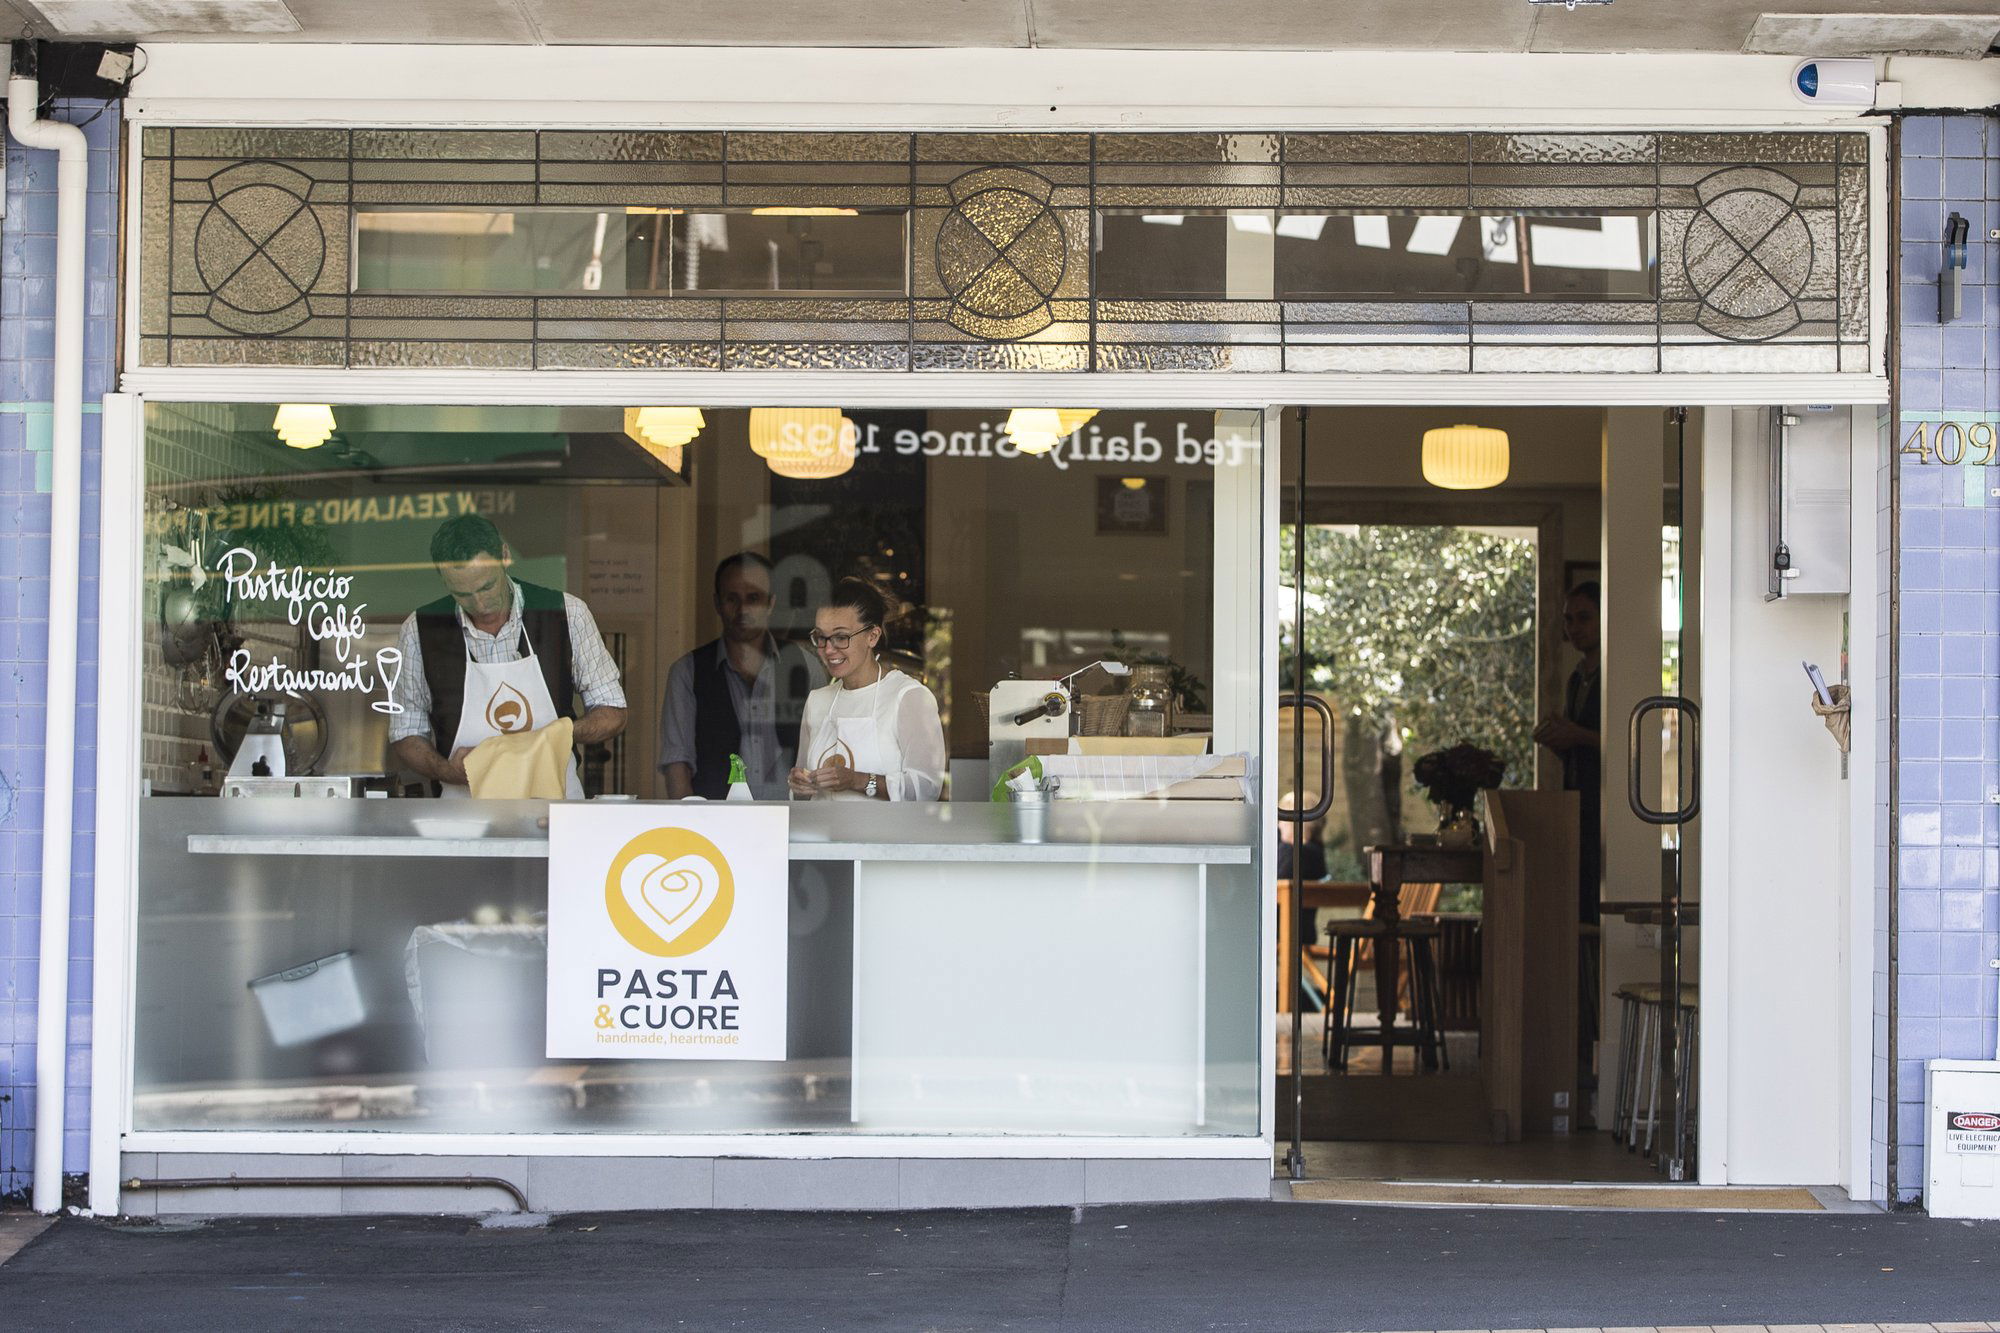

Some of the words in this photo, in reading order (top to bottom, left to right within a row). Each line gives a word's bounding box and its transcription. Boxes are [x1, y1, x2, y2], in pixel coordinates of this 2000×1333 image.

[1900, 421, 1997, 466] 409
[216, 547, 354, 626] Pastificio
[307, 601, 368, 663] Café
[225, 648, 375, 695] Restaurant
[597, 968, 739, 1000] PASTA
[593, 1004, 616, 1030] &
[619, 1004, 739, 1031] CUORE
[596, 1031, 667, 1045] handmade,
[669, 1031, 739, 1045] heartmade
[1957, 1117, 1997, 1126] DANGER
[1957, 1143, 1997, 1151] EQUIPMENT
